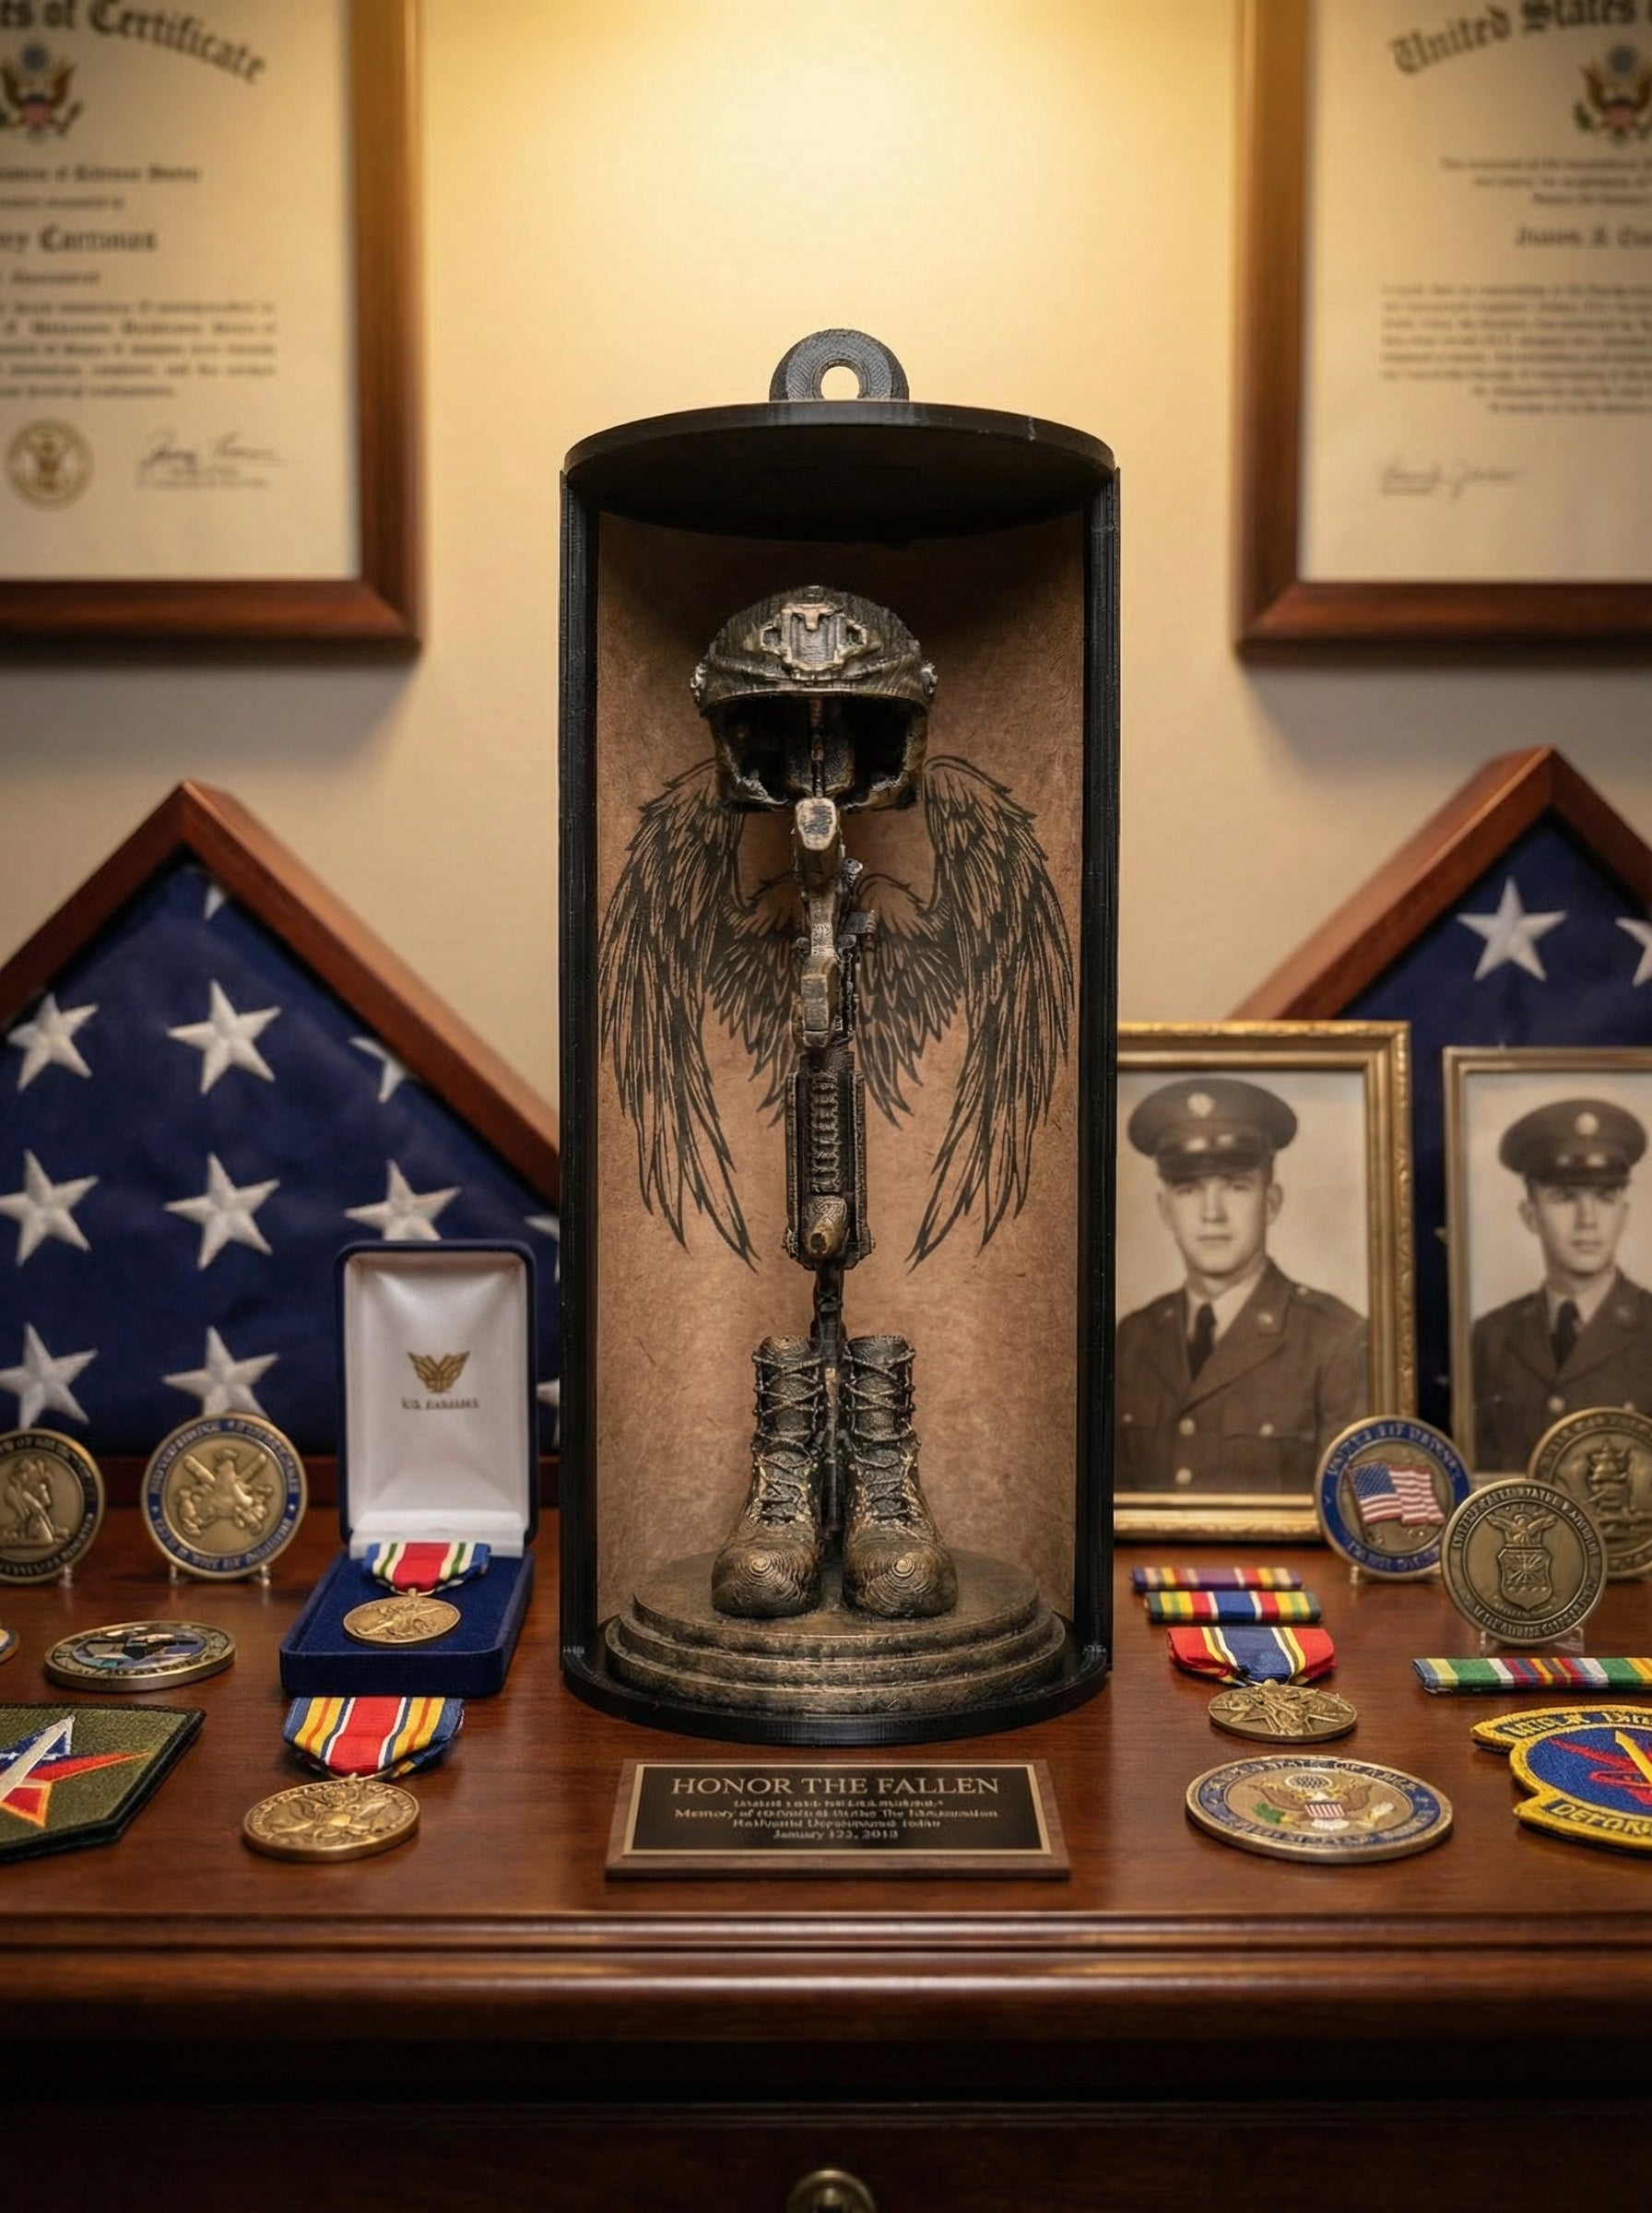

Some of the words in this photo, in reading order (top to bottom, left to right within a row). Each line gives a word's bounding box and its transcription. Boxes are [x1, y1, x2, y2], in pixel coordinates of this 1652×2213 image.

[88, 0, 266, 84] Certificate
[1389, 6, 1511, 75] United
[1521, 0, 1637, 31] States
[671, 1778, 794, 1794] HONOR
[801, 1778, 868, 1794] THE
[878, 1777, 999, 1794] FALLEN
